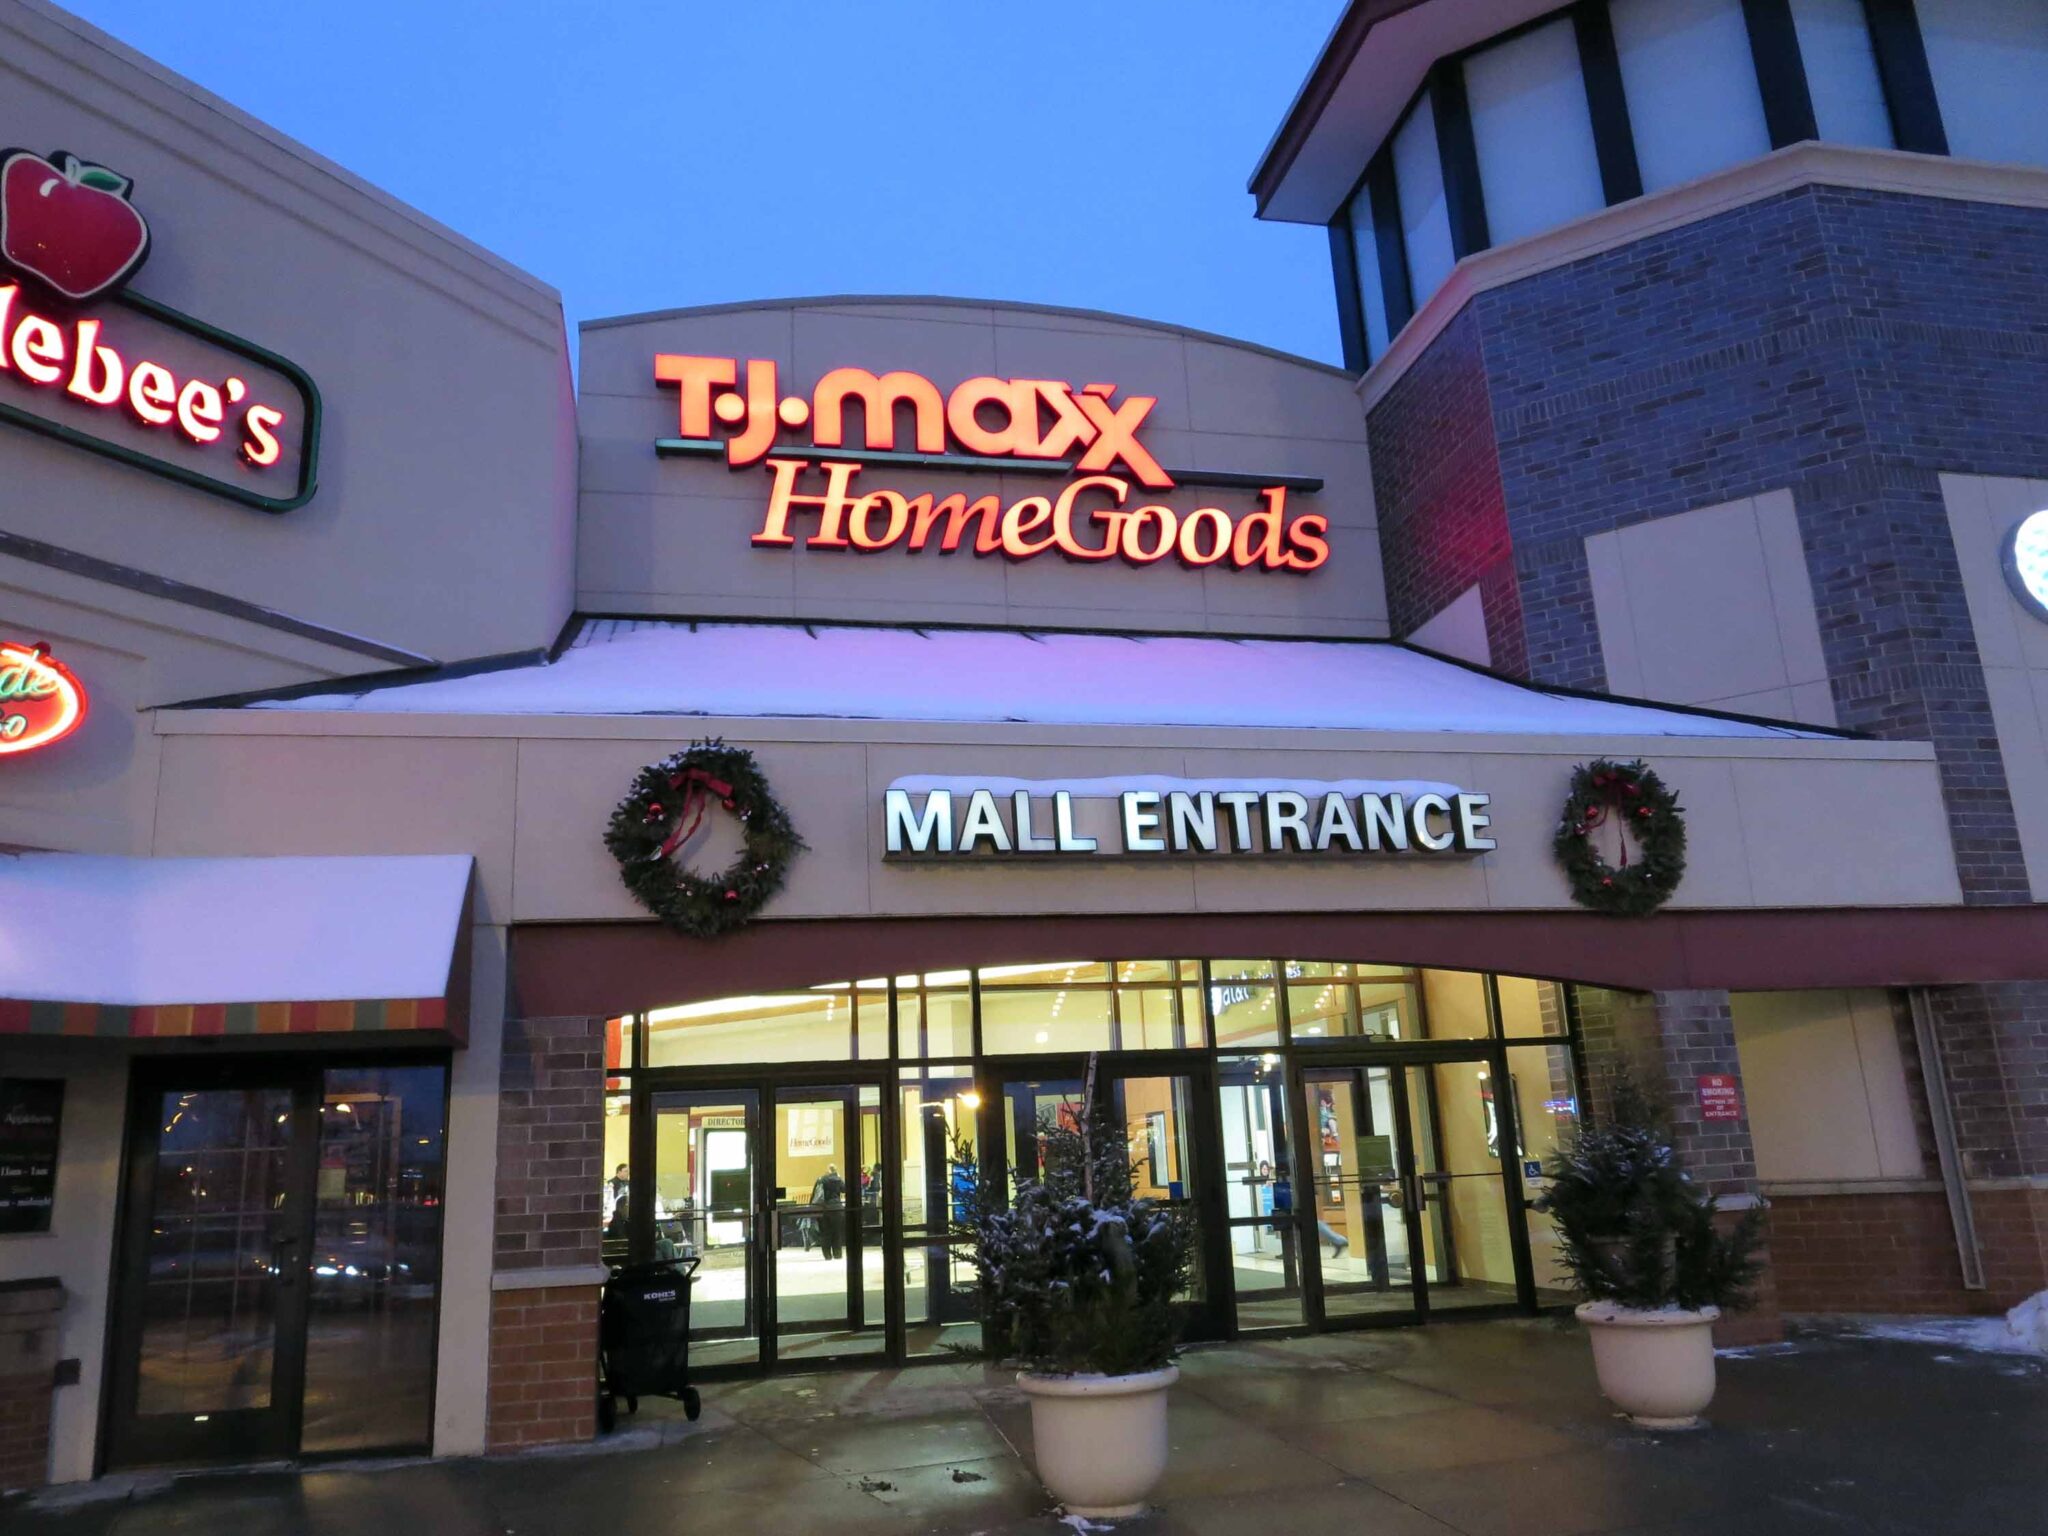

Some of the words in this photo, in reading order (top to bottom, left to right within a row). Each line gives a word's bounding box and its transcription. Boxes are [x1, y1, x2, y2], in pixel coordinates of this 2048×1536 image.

[751, 458, 1330, 572] HomeGoods
[885, 789, 1097, 852] MALL
[1122, 791, 1498, 852] ENTRANCE
